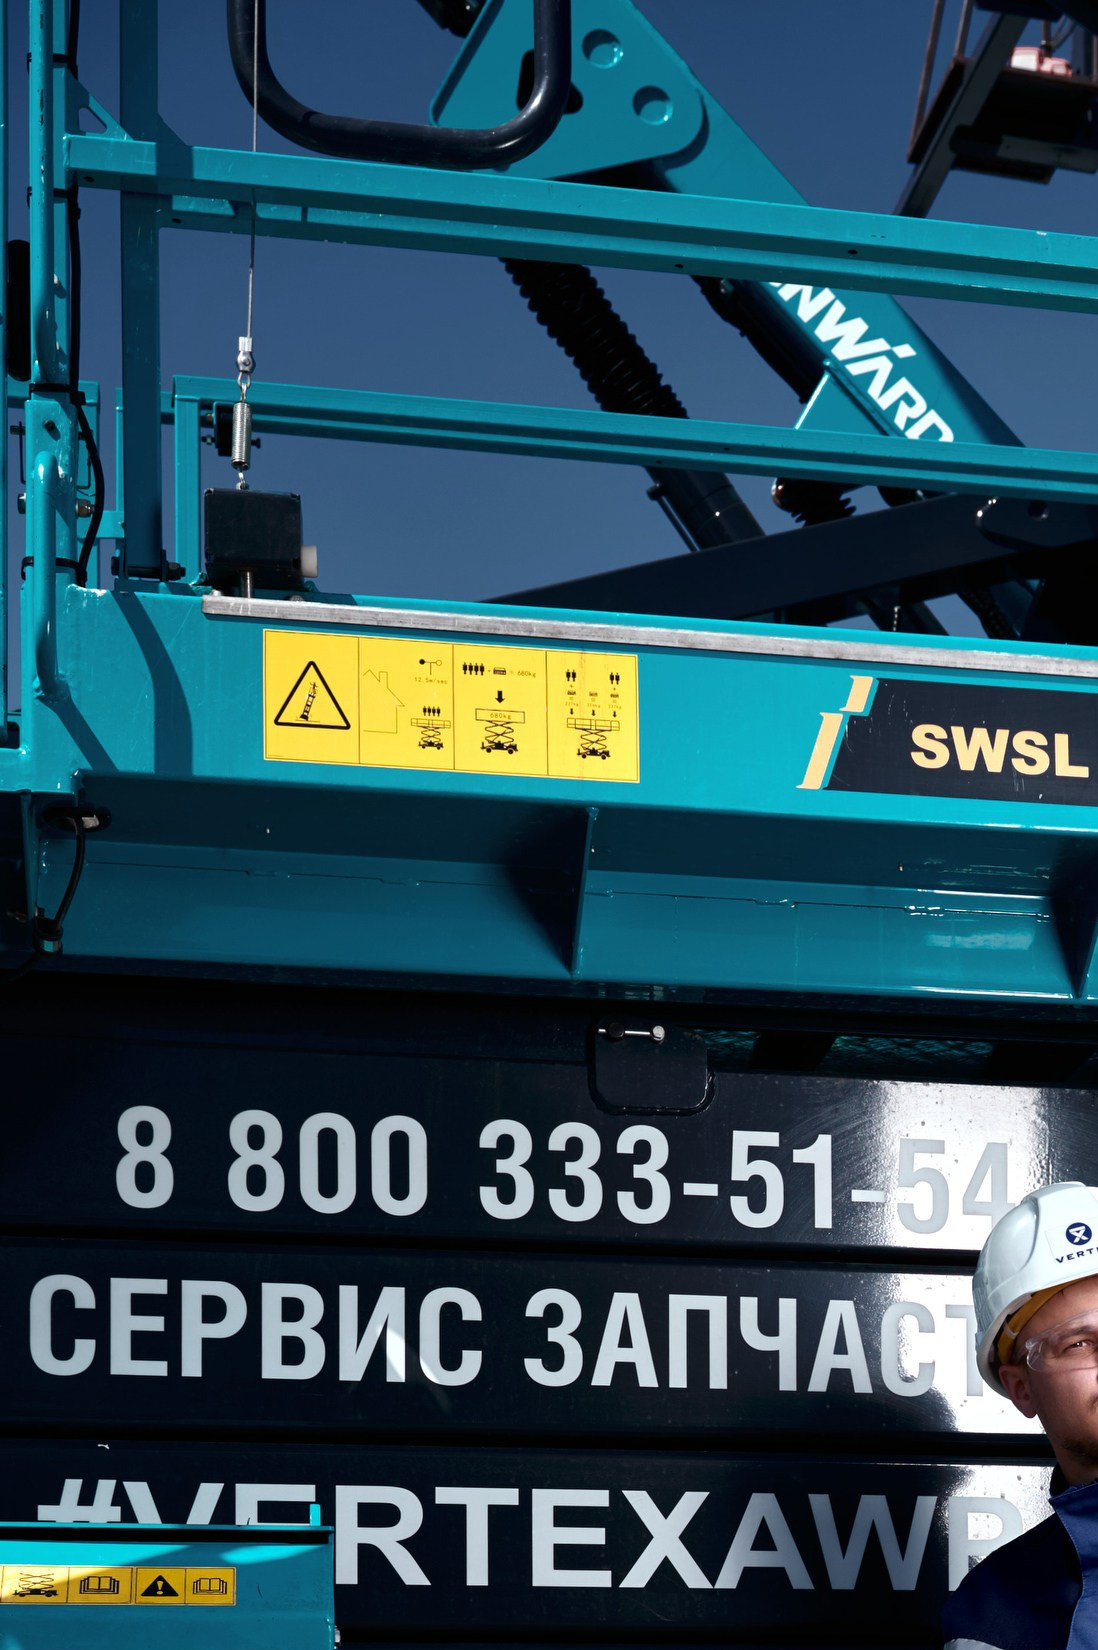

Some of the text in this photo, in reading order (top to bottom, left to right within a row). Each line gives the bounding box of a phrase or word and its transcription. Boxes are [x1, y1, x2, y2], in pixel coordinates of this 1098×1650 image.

[769, 282, 954, 443] NWARD
[490, 712, 512, 720] 680kg
[910, 723, 1089, 778] SWSL
[116, 1105, 1016, 1234] 8 800 333-51-54
[29, 1273, 483, 1386] СЕРВИС
